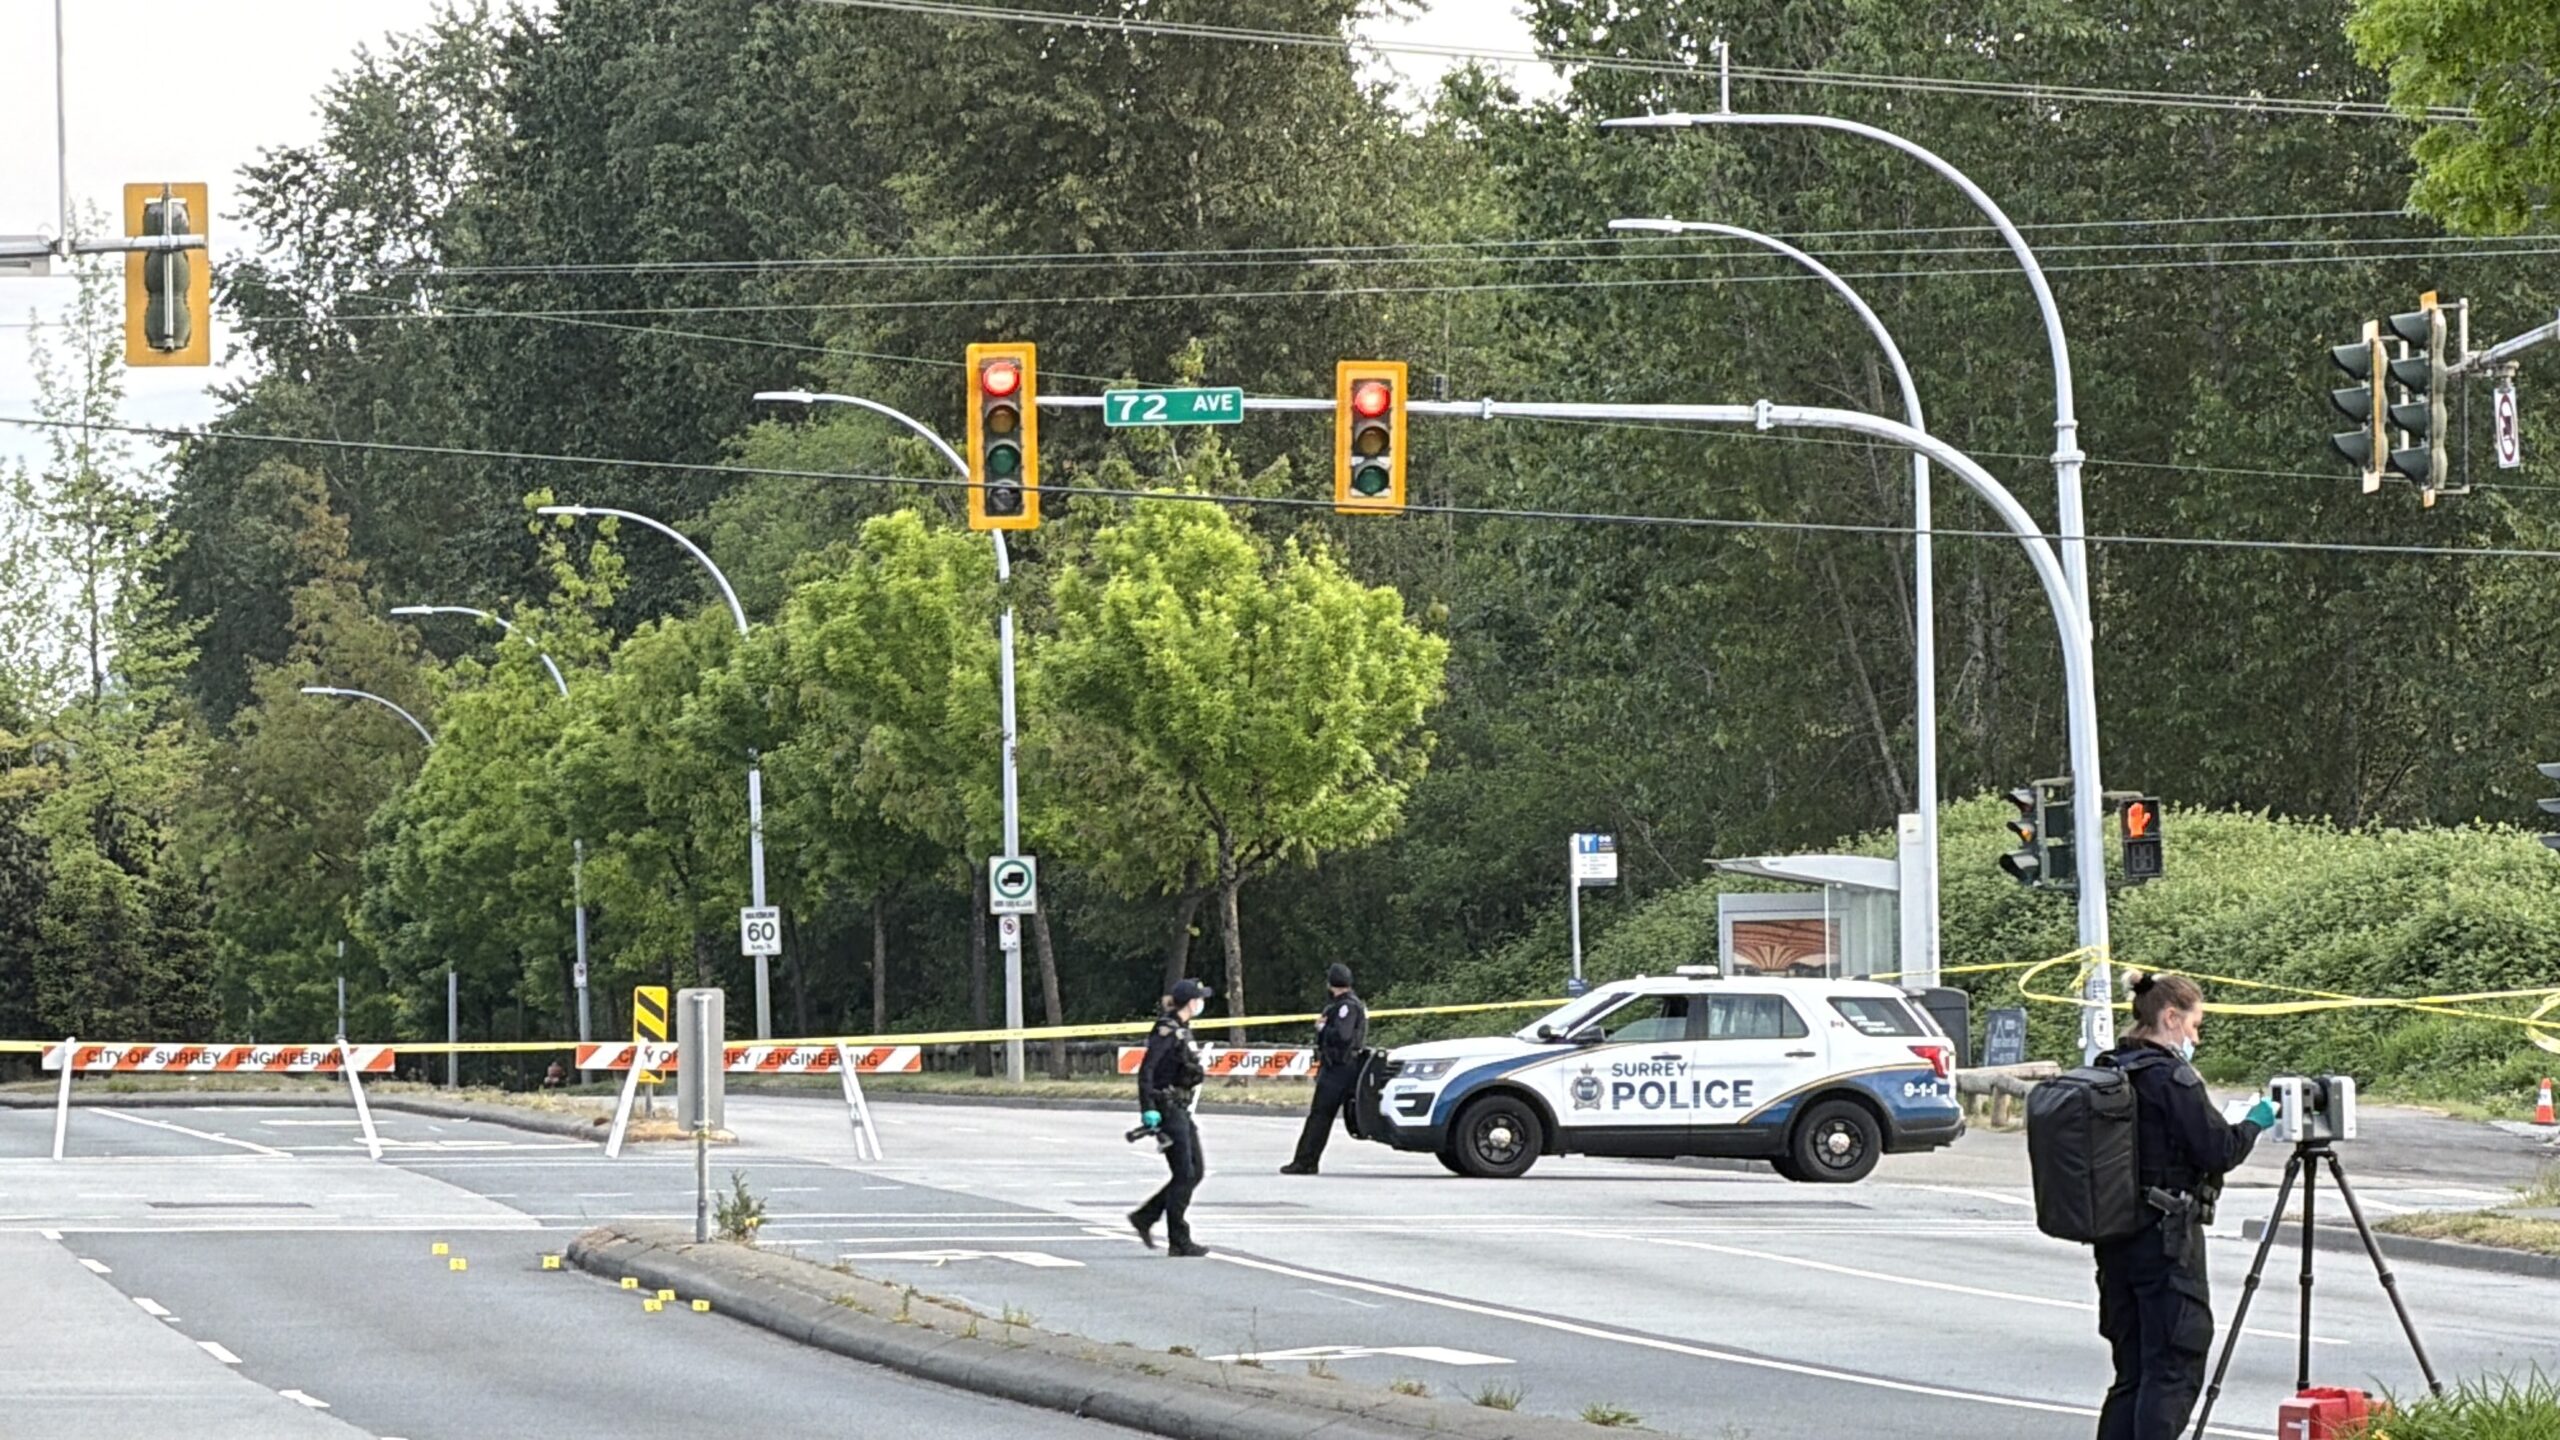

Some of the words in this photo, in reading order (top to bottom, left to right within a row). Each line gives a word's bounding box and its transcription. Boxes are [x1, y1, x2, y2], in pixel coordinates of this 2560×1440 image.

[1113, 395, 1168, 421] 72
[1193, 394, 1234, 412] AVE
[747, 922, 775, 942] 60
[86, 1050, 122, 1064] CITY
[128, 1051, 150, 1064] OF
[155, 1051, 221, 1065] SURREY
[1229, 1054, 1293, 1069] SURREY
[1611, 1062, 1688, 1077] SURREY
[1612, 1080, 1753, 1110] POLICE
[1904, 1082, 1938, 1097] 9-1-1
